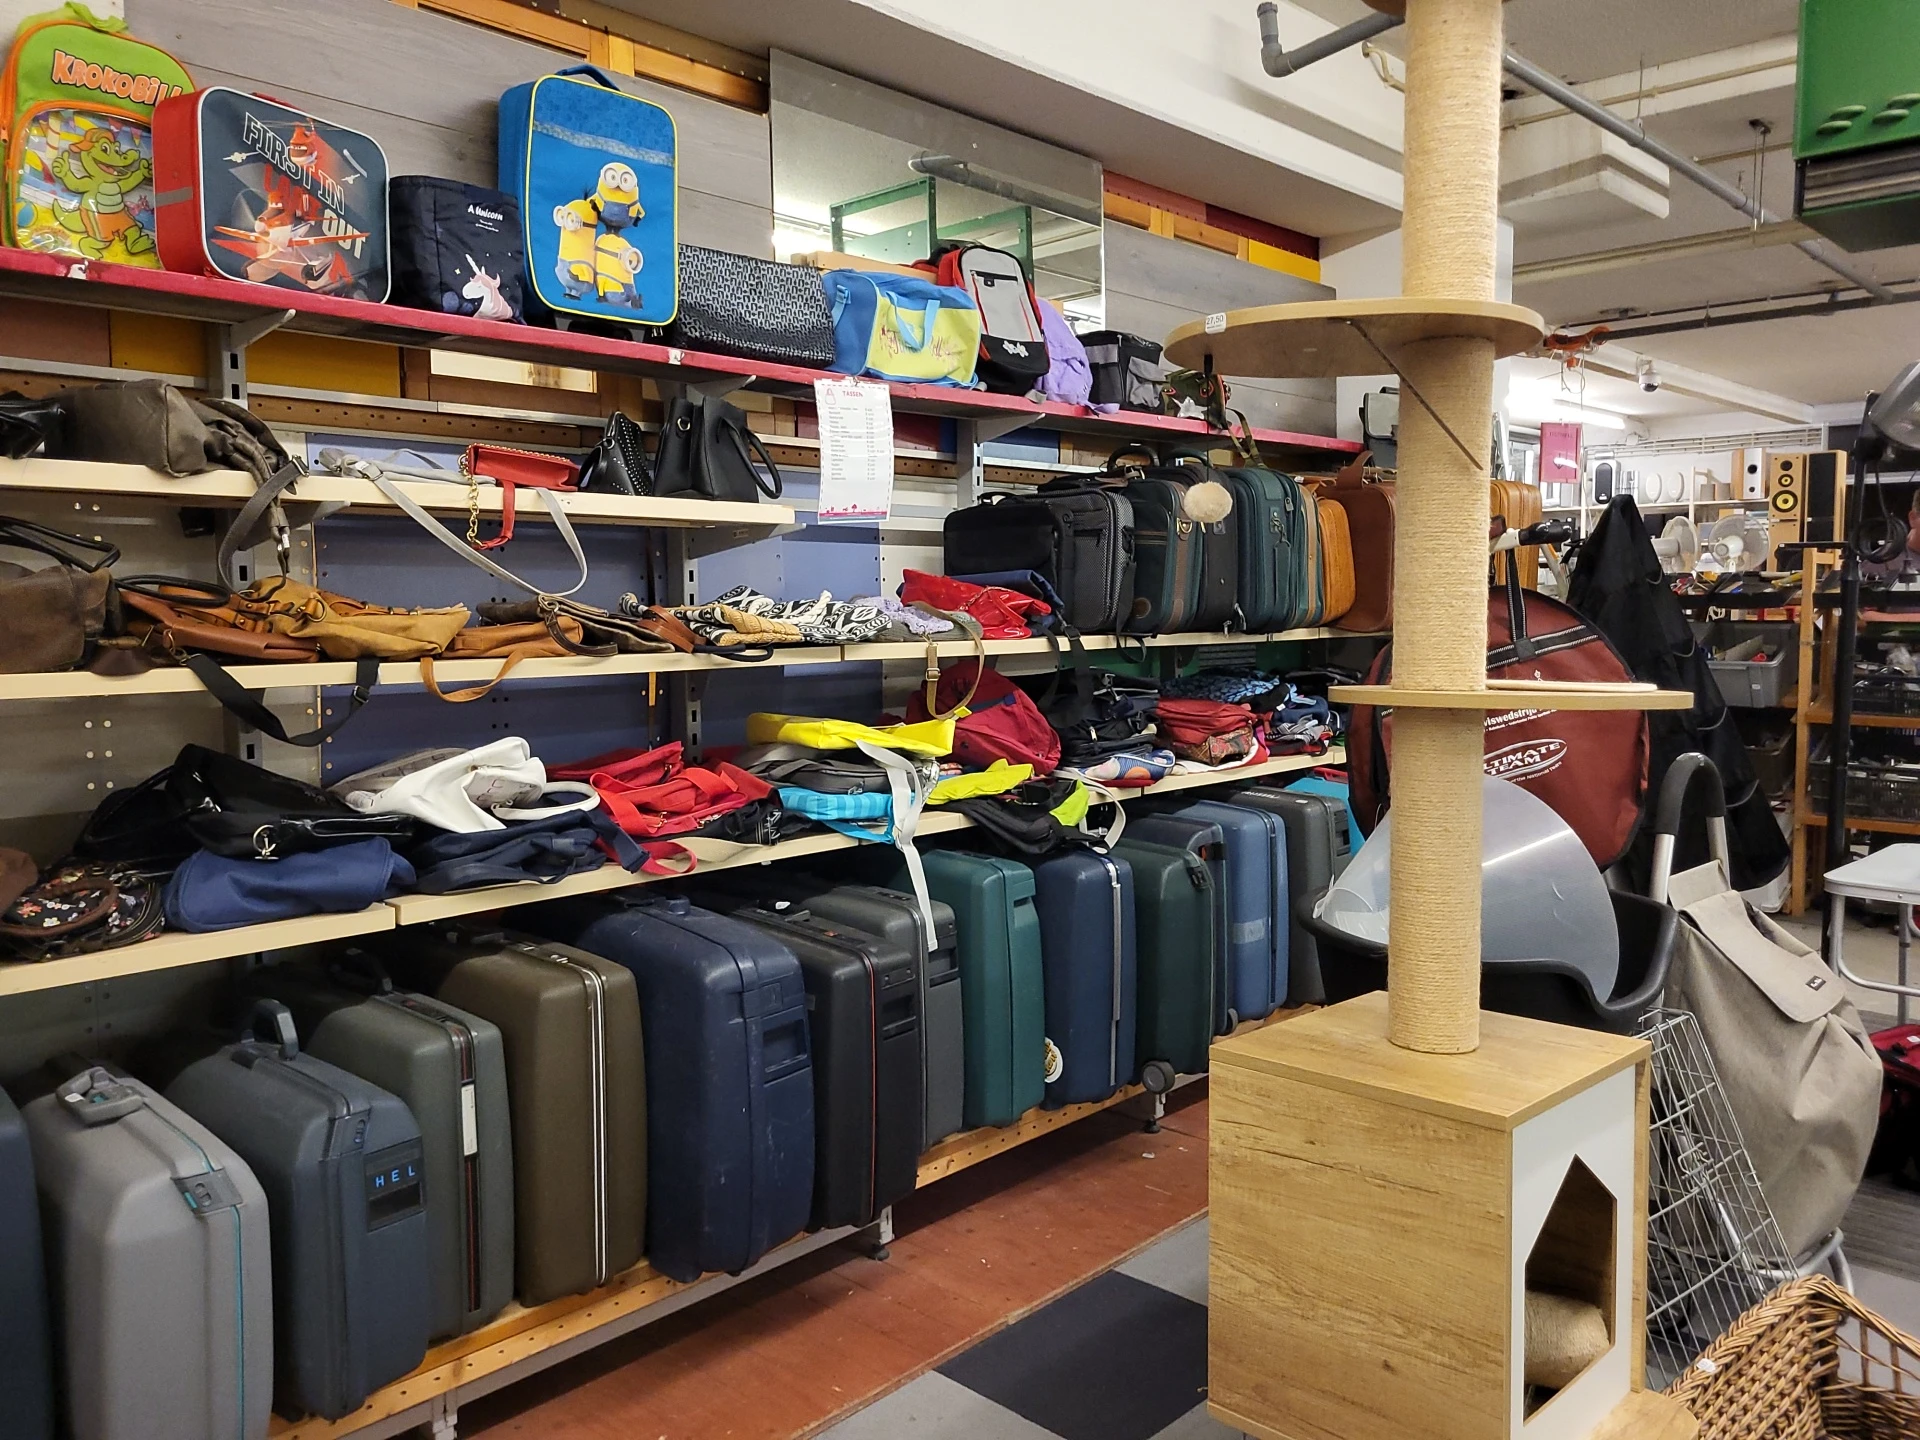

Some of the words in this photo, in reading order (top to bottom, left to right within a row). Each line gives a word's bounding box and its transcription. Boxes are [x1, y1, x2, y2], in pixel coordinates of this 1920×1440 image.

[243, 112, 315, 189] FIRST
[318, 169, 345, 216] IN
[468, 204, 474, 214] A
[321, 208, 366, 260] OUT
[1206, 315, 1223, 324] 27,50
[842, 390, 864, 398] TASSEN
[1484, 742, 1561, 770] LTIMATE
[1487, 755, 1540, 775] TEAM
[375, 1165, 416, 1188] HEL
